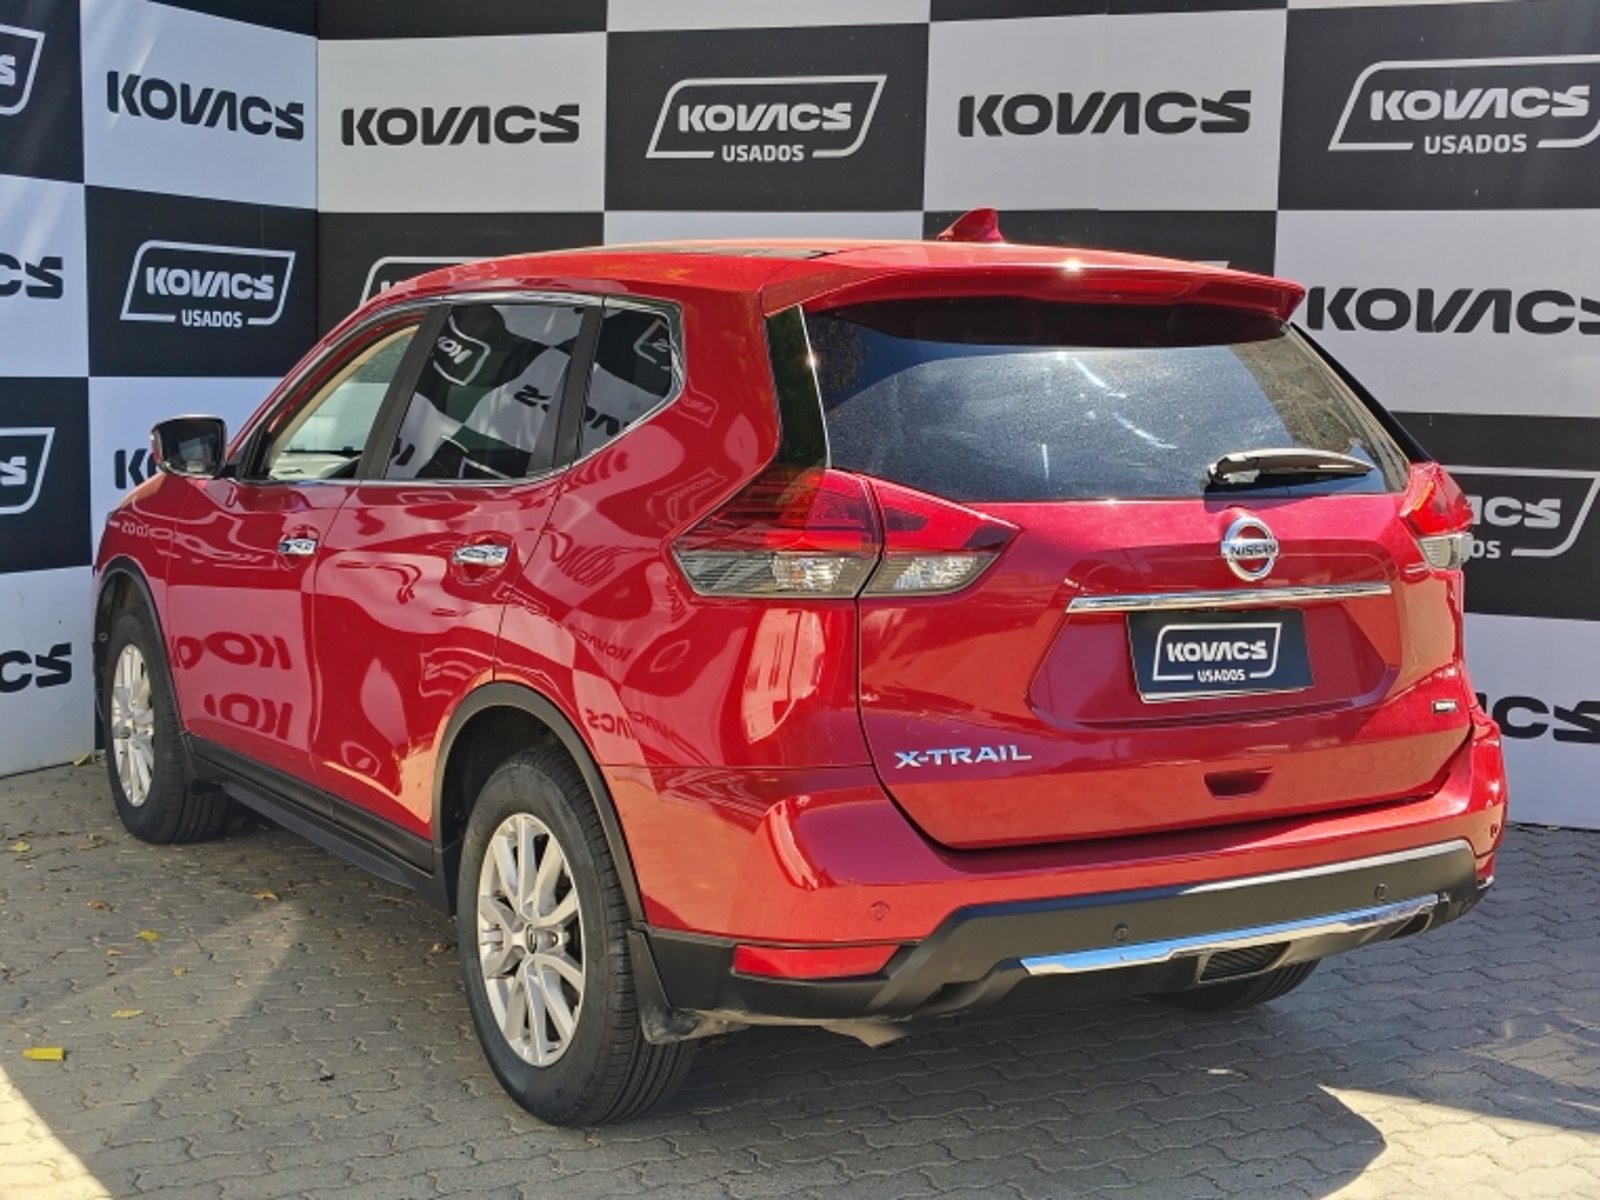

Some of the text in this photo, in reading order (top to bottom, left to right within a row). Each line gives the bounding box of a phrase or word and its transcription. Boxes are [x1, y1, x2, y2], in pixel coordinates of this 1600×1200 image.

[107, 71, 304, 140] KOVACS
[957, 90, 1251, 137] KOVACS
[1370, 85, 1590, 121] KOVACS
[342, 103, 580, 146] KOVACS
[678, 102, 852, 132] KOVACS
[722, 144, 805, 162] USADOS
[1424, 133, 1527, 155] USADOS
[146, 267, 274, 301] KOVACS
[181, 309, 243, 328] USADOS
[1231, 545, 1276, 556] NISSAN
[1166, 640, 1268, 662] KOVACS
[1197, 669, 1246, 683] USADOS
[894, 744, 1033, 769] X-TRAIL
